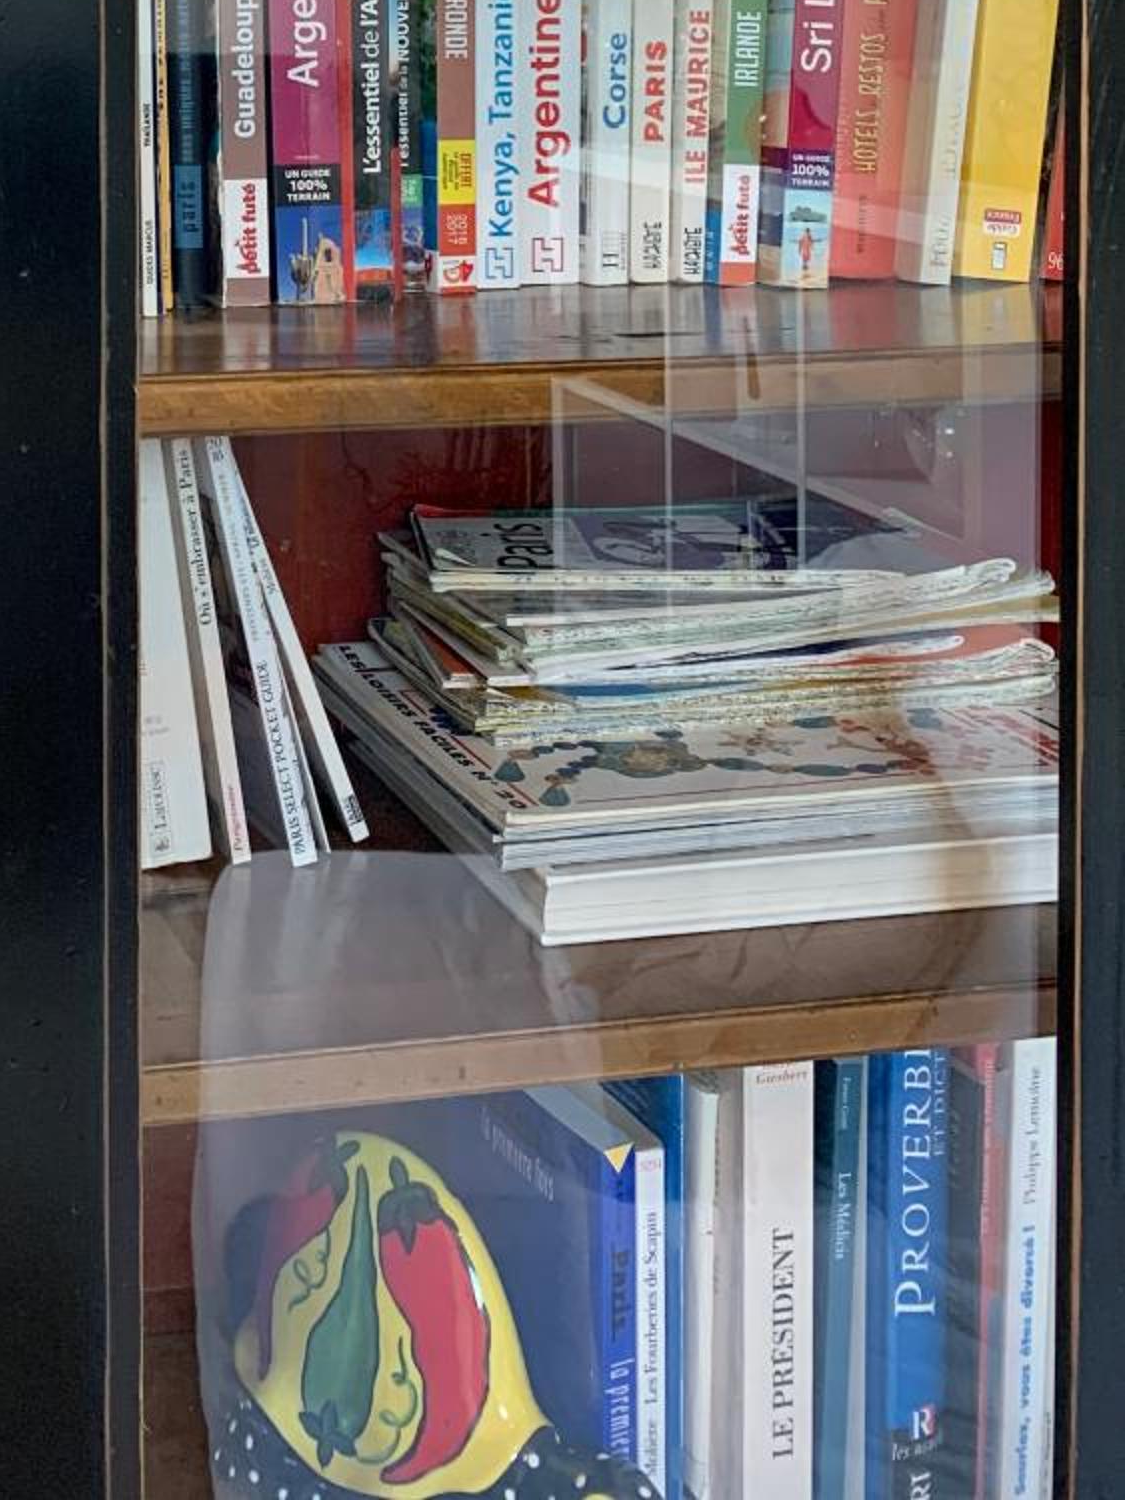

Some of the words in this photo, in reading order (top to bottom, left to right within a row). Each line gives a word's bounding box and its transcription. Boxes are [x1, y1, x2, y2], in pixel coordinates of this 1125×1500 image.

[363, 31, 380, 58] de
[734, 11, 761, 87] IRLANDE
[801, 22, 834, 72] Sri
[857, 33, 886, 97] RESTOS
[602, 32, 628, 129] Corse
[644, 40, 667, 142] PARIS
[686, 10, 710, 138] MAURICE
[362, 63, 381, 174] L'essentiel
[284, 169, 299, 179] UN
[300, 168, 331, 179] GUIDE
[289, 179, 328, 192] 100%
[460, 153, 472, 187] OFFERT
[487, 132, 517, 237] Kenya,
[685, 151, 705, 184] ILE
[791, 163, 830, 177] 100%
[791, 178, 830, 187] TERRAIN
[239, 183, 257, 222] futé
[286, 192, 331, 203] TERRAIN
[734, 174, 751, 210] futé
[144, 219, 152, 253] MARCUS
[731, 212, 753, 257] petit
[987, 224, 1017, 235] Guide
[175, 449, 191, 489] Paris
[481, 523, 560, 574] paris
[254, 659, 275, 703] GUIDE
[338, 645, 366, 670] LES
[362, 673, 415, 718] LOISIRS
[414, 720, 475, 767] FACILES
[263, 706, 288, 762] POCKET
[276, 766, 298, 814] SELECT
[285, 816, 306, 855] PARIS
[933, 1125, 945, 1157] ET
[838, 1170, 852, 1198] Les
[1022, 1139, 1042, 1206] Philippe
[644, 1211, 661, 1264] Scapin
[835, 1202, 850, 1260] Médicis
[644, 1267, 658, 1287] de
[1019, 1236, 1035, 1309] divorcé
[644, 1291, 658, 1373] Fourberies
[1018, 1315, 1033, 1357] êtes
[611, 1357, 633, 1379] la
[1017, 1364, 1031, 1408] vous
[645, 1378, 658, 1405] Les
[772, 1423, 794, 1459] LE
[1013, 1417, 1032, 1496] Souriez,
